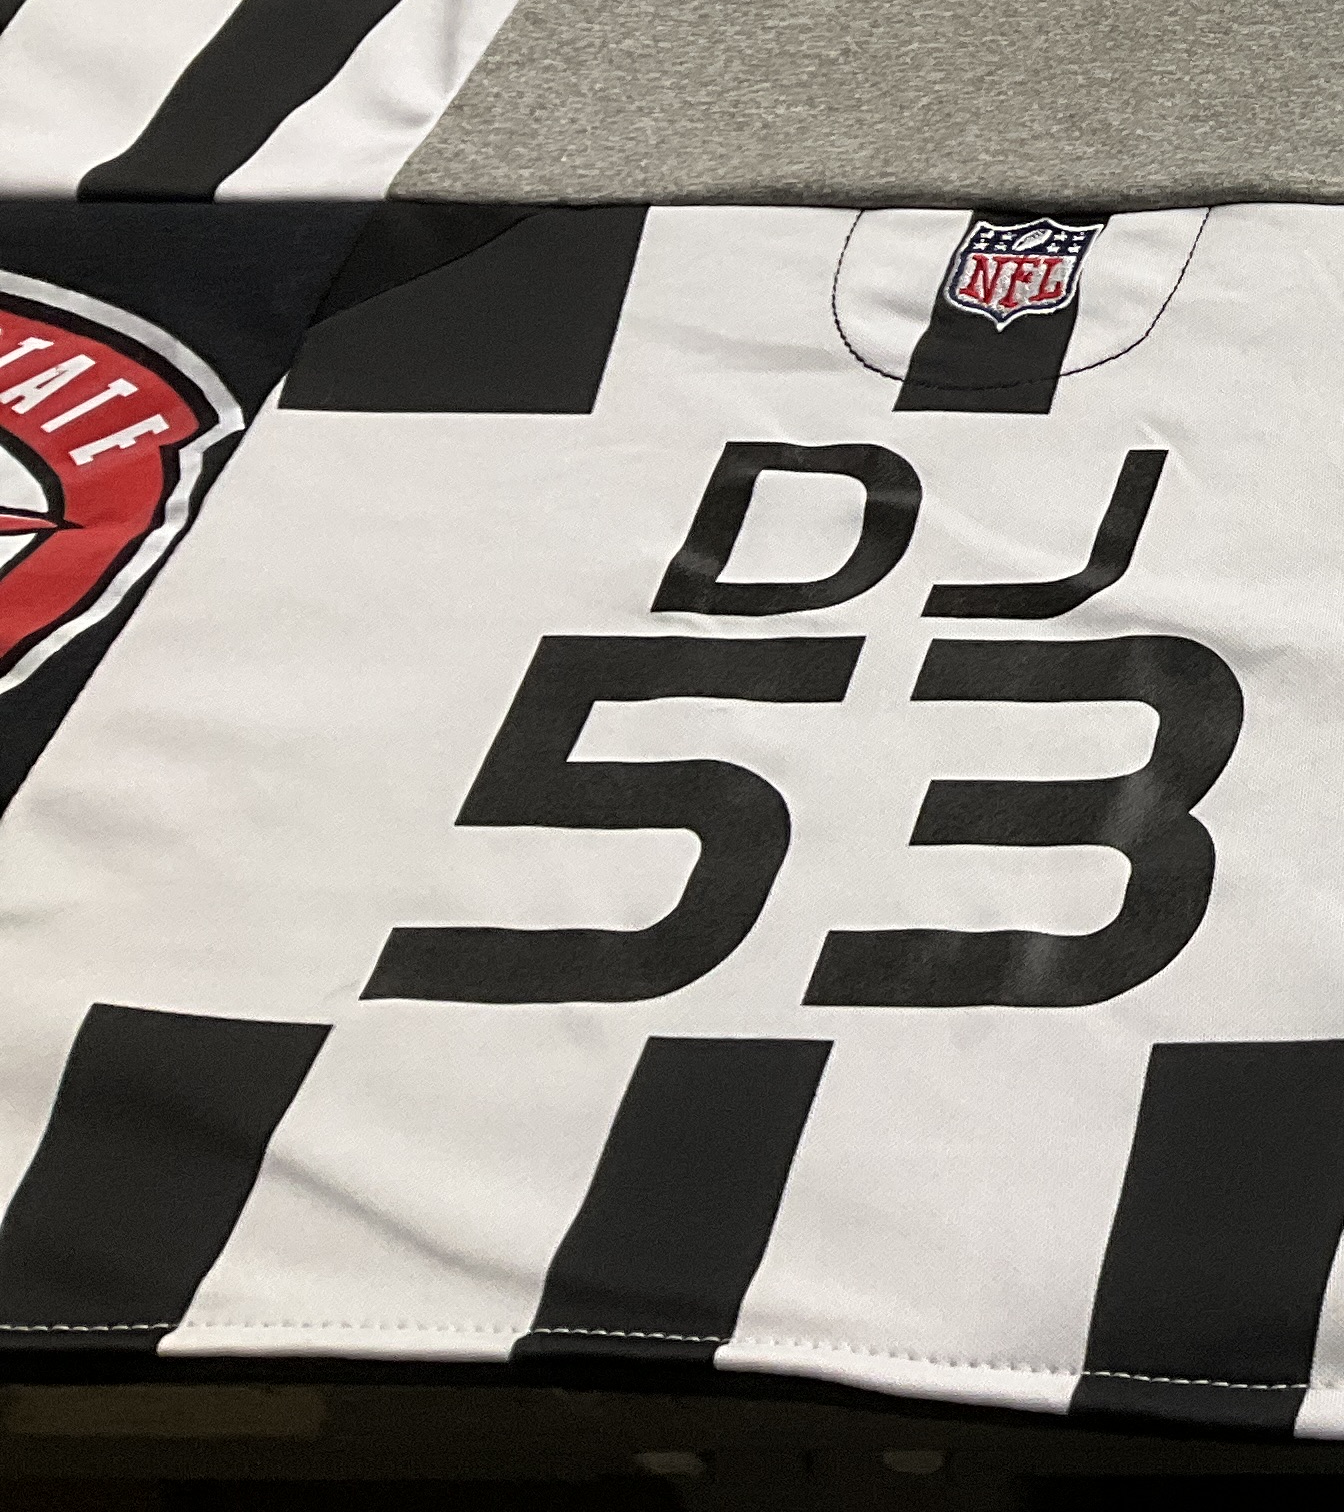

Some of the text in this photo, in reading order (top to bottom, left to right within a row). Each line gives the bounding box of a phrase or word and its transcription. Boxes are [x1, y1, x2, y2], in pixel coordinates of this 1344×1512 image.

[959, 254, 1064, 308] NFL
[0, 328, 170, 466] TATE
[652, 440, 1170, 622] DJ
[360, 633, 1245, 1008] 53
